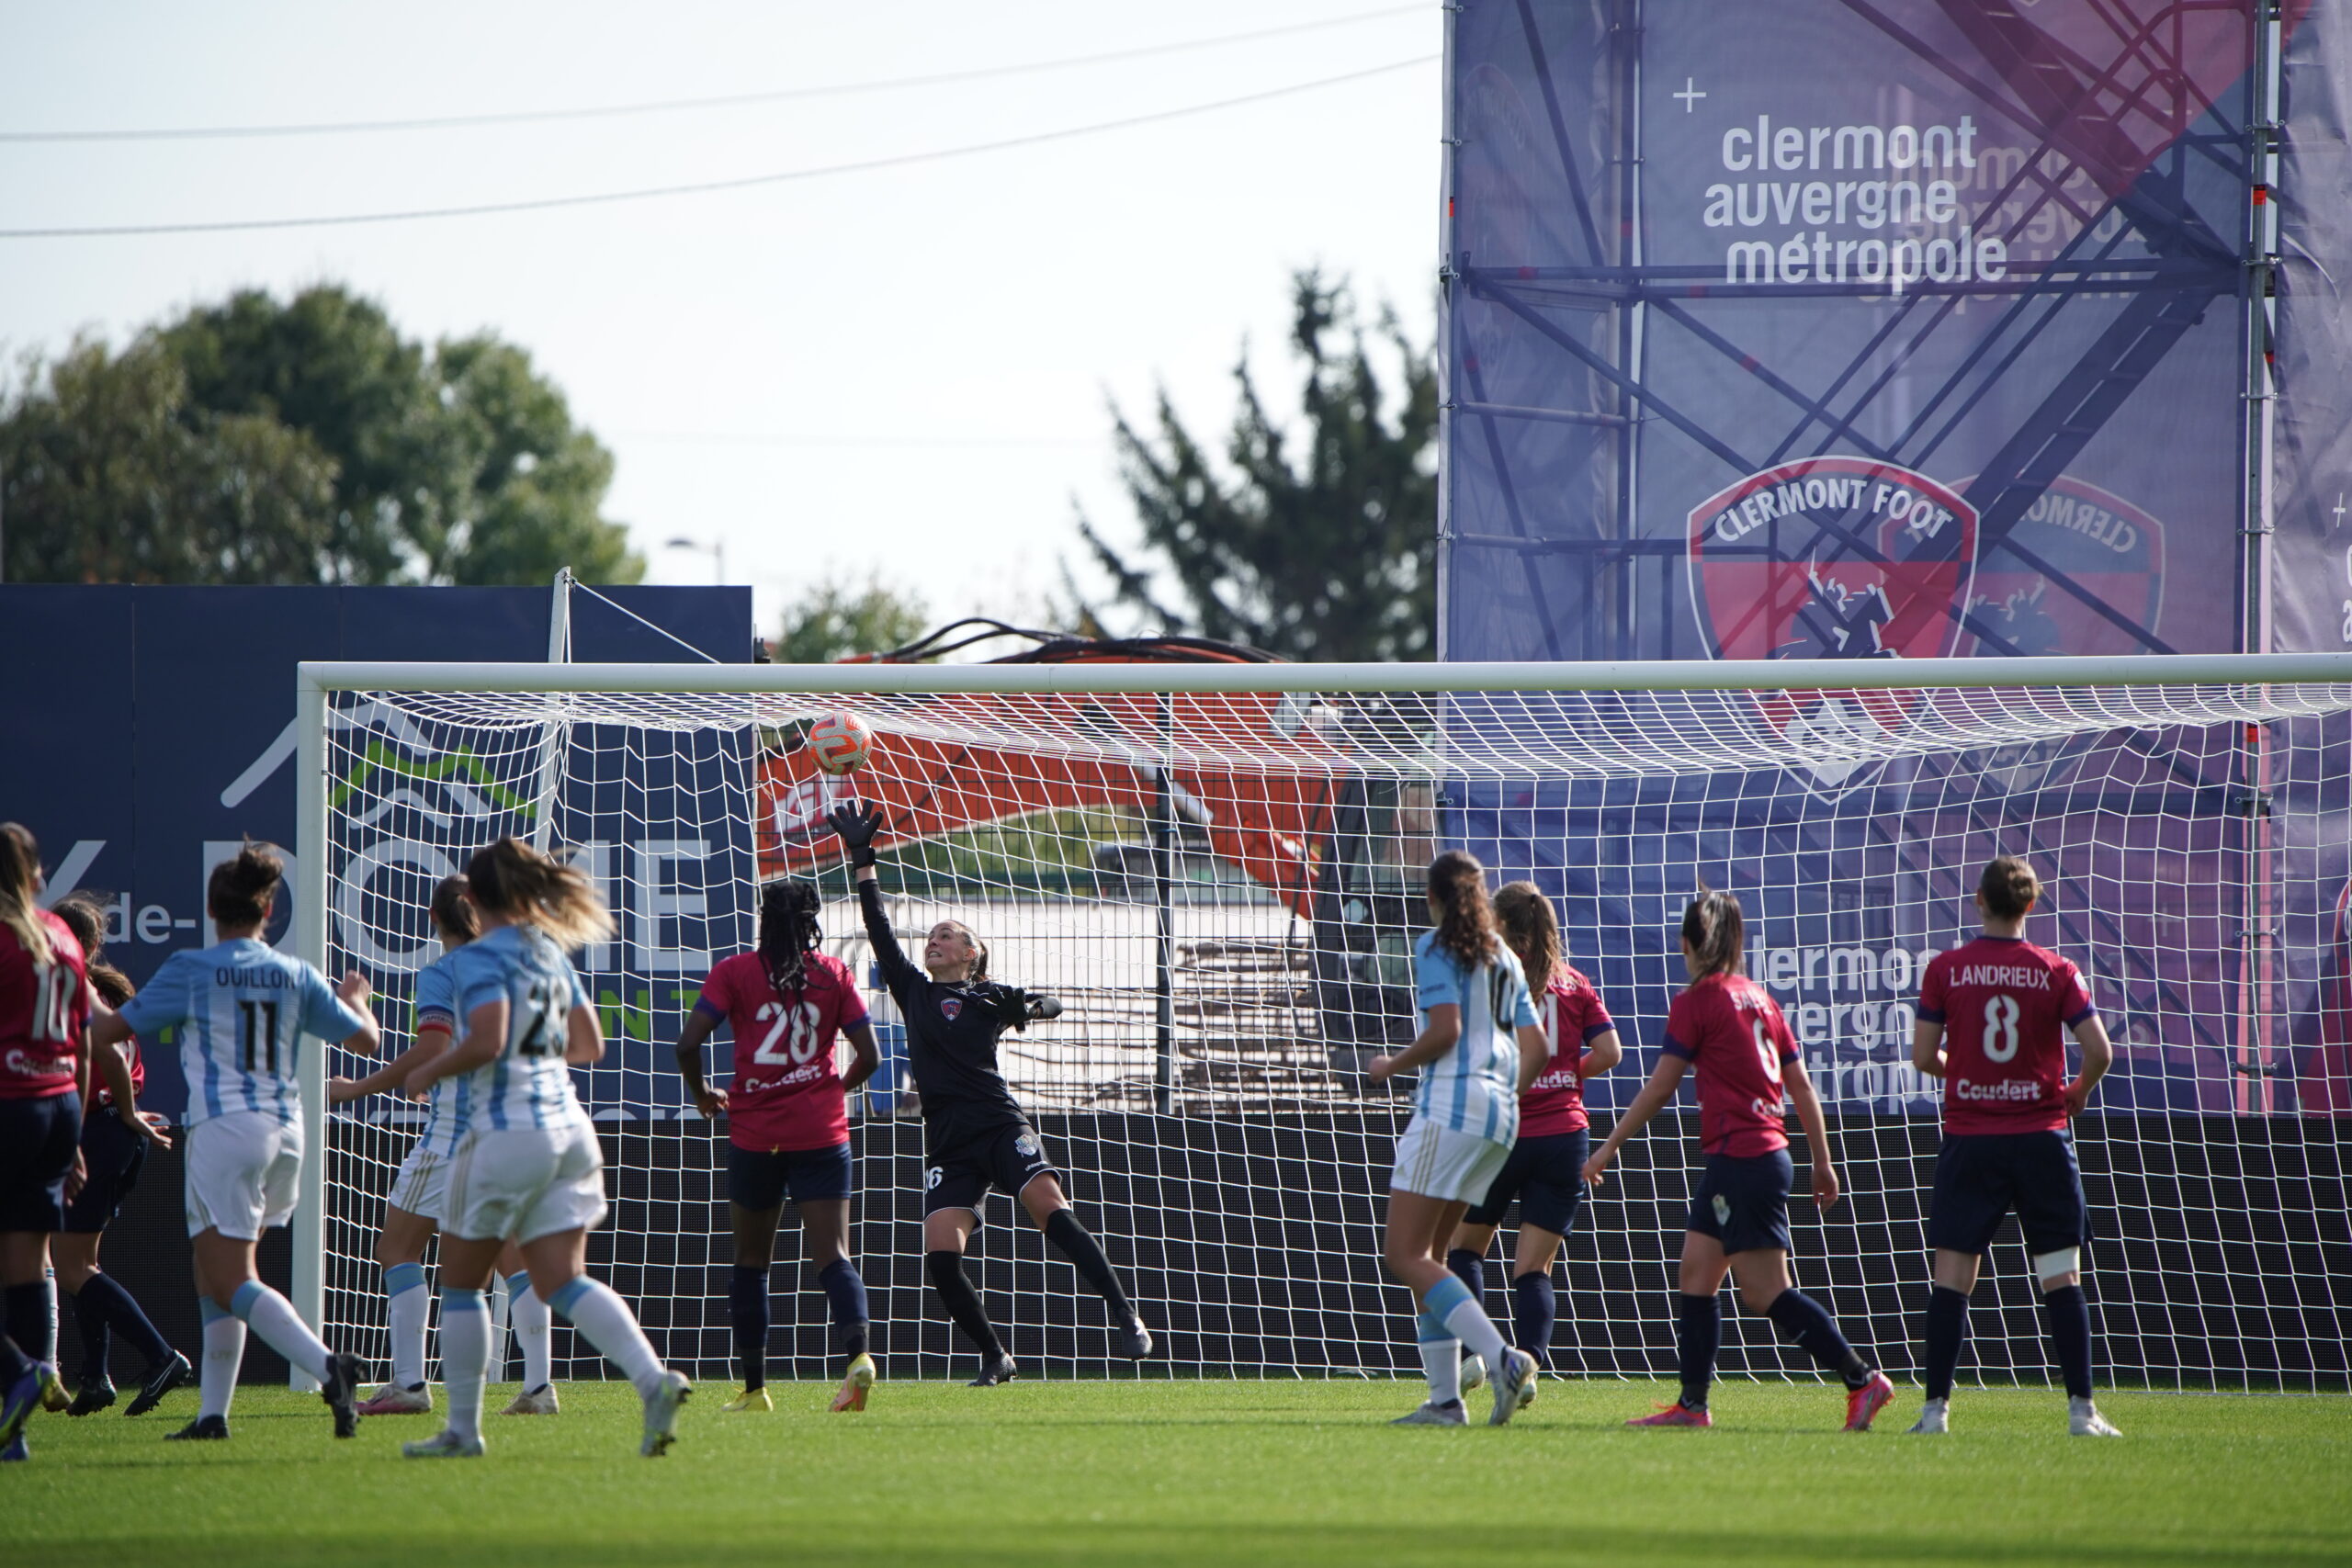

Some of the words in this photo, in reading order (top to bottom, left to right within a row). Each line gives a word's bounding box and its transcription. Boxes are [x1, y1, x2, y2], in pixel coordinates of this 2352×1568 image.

[1722, 115, 1977, 171] clermont
[1703, 180, 1957, 229] auvergne
[1726, 226, 2007, 296] métropole
[1714, 478, 1867, 543] CLERMONT
[1873, 484, 1953, 539] FOOT
[31, 962, 77, 1042] 10
[1950, 964, 2051, 991] LANDRIEUX
[237, 1000, 277, 1072] 11
[753, 1001, 820, 1066] 28
[1752, 1018, 1781, 1084] 6
[1983, 994, 2020, 1064] 8
[1956, 1078, 2041, 1100] Coudert
